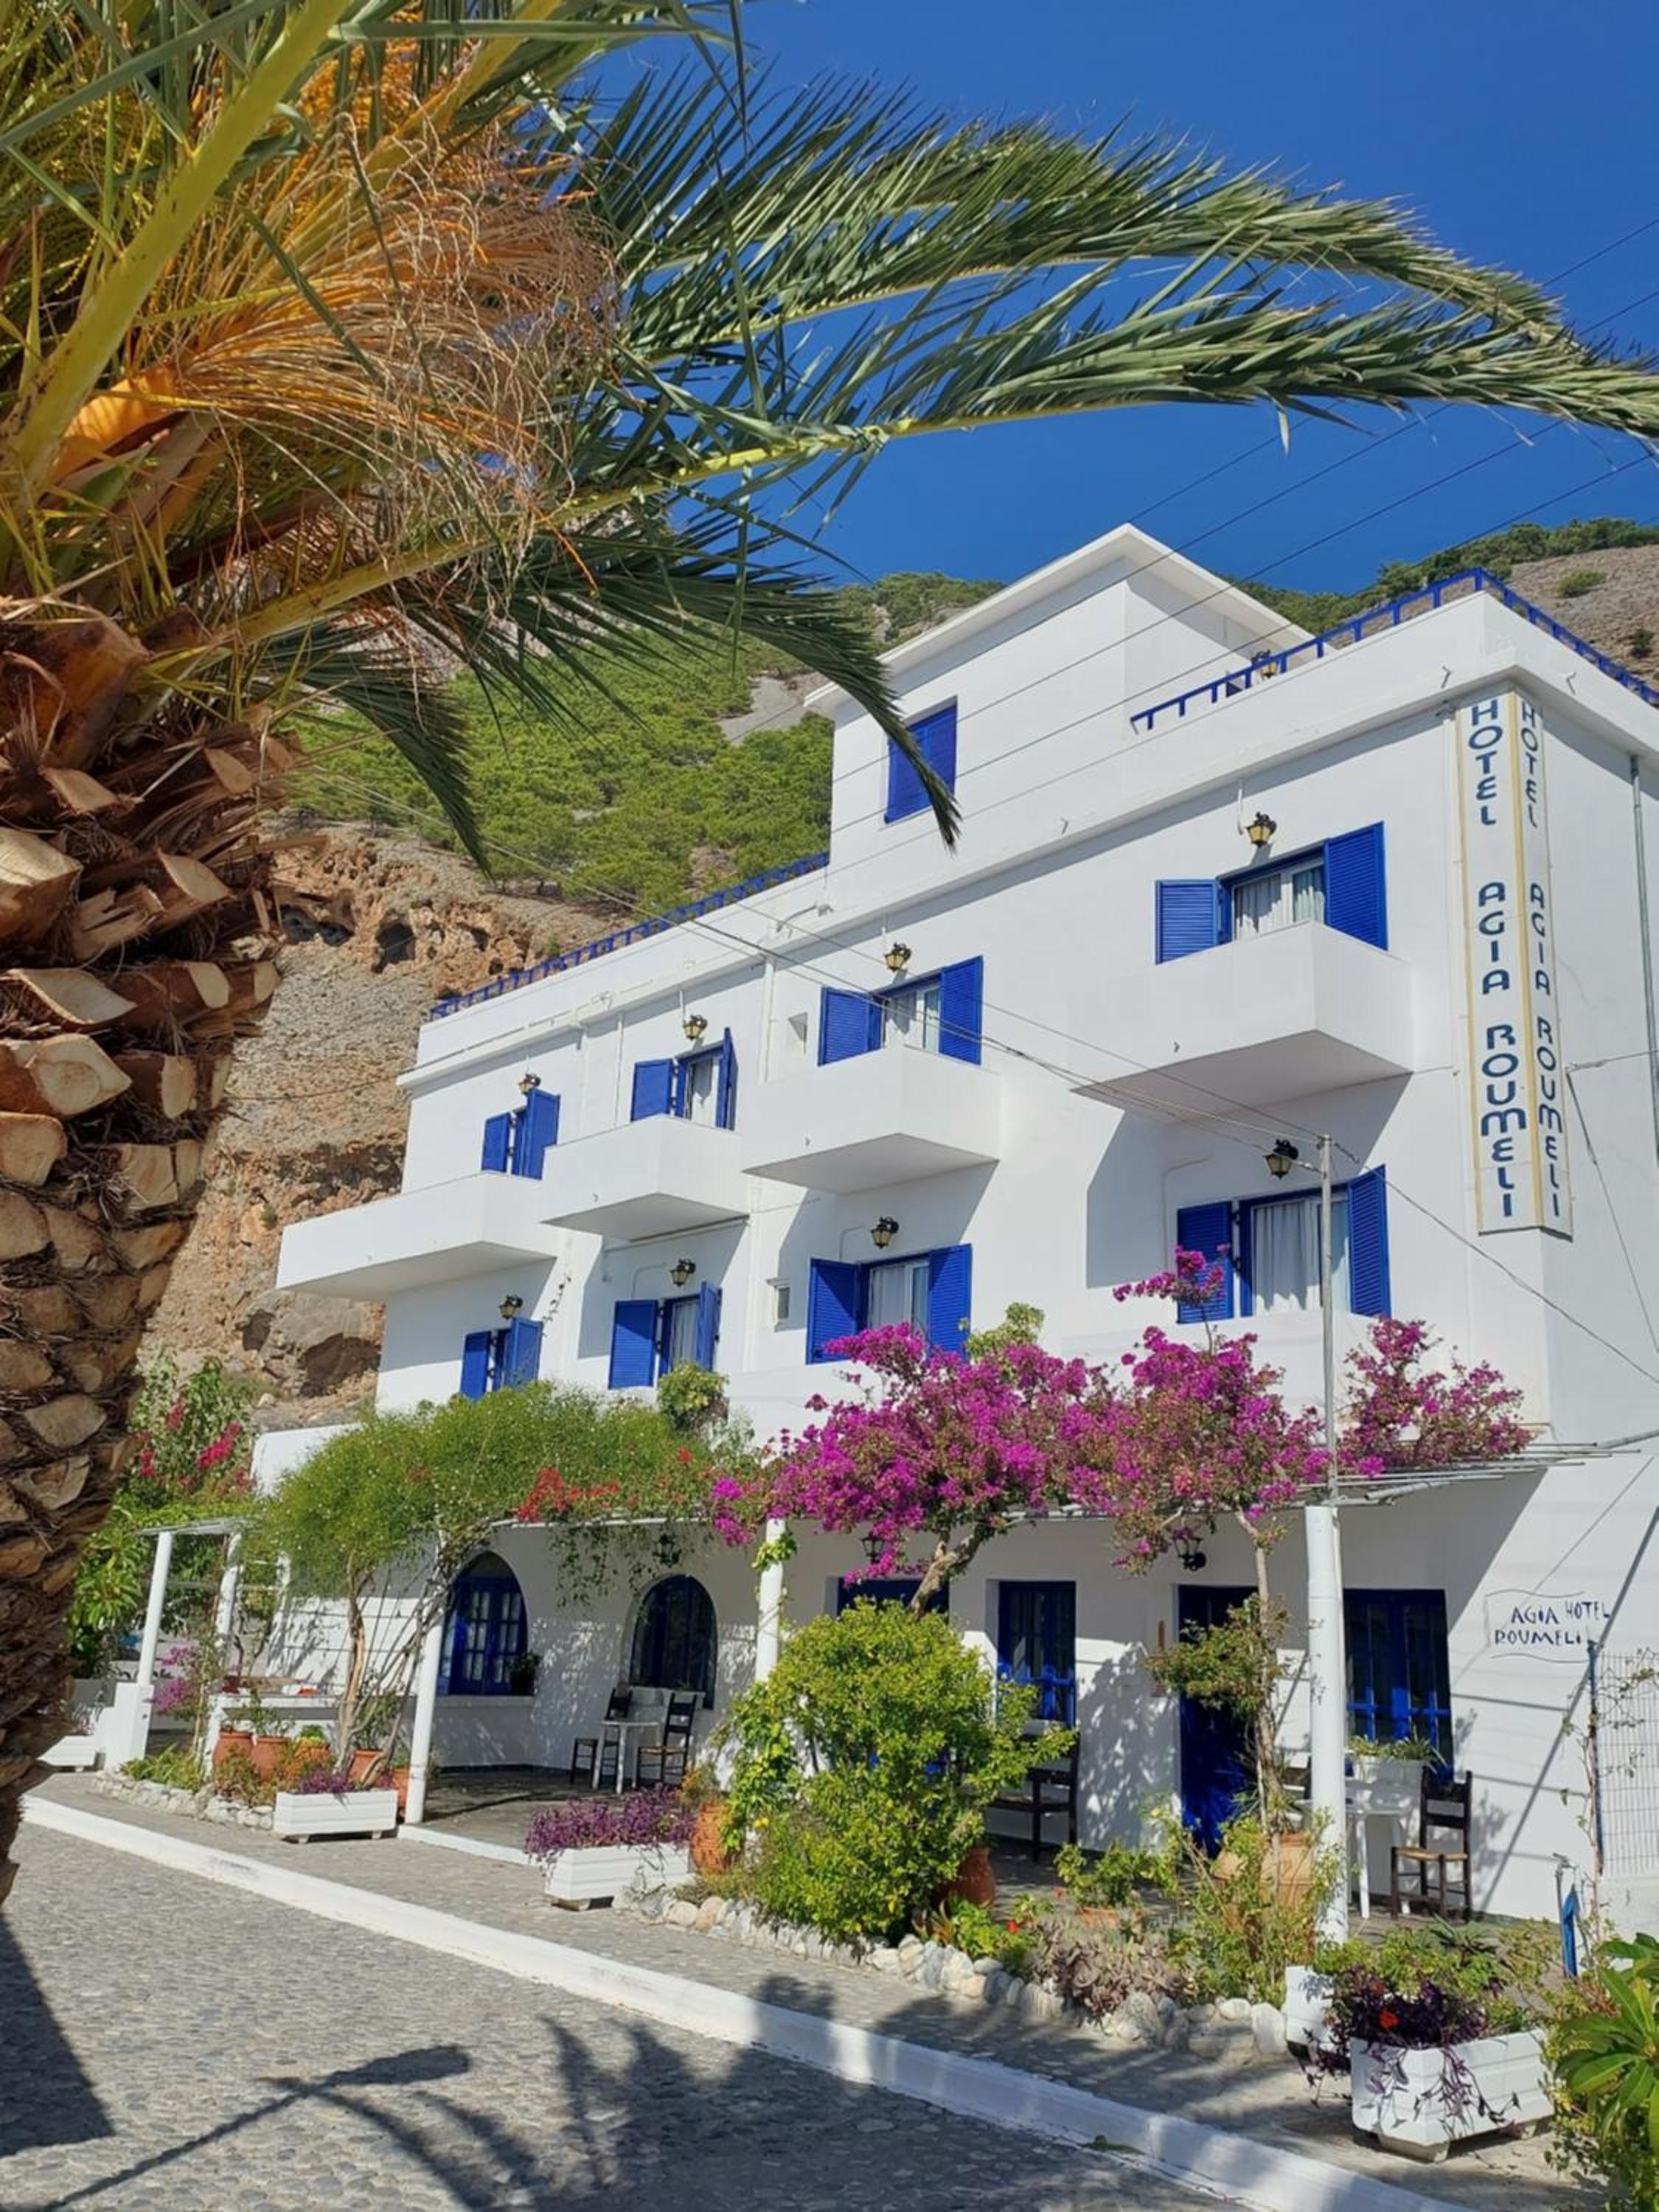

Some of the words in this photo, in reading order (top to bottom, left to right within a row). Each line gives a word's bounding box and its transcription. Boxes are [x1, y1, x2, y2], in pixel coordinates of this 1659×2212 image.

[1468, 699, 1503, 826] HOTEL
[1520, 701, 1539, 829] HOTEL
[1478, 882, 1511, 995] AGIA
[1530, 882, 1551, 995] AGIA
[1481, 1023, 1527, 1217] ROUMELI
[1536, 1016, 1563, 1217] ROUMELI
[1494, 1629, 1582, 1646] ROUMELI
[1511, 1606, 1559, 1625] AGIA
[1565, 1601, 1611, 1619] HOTEL
